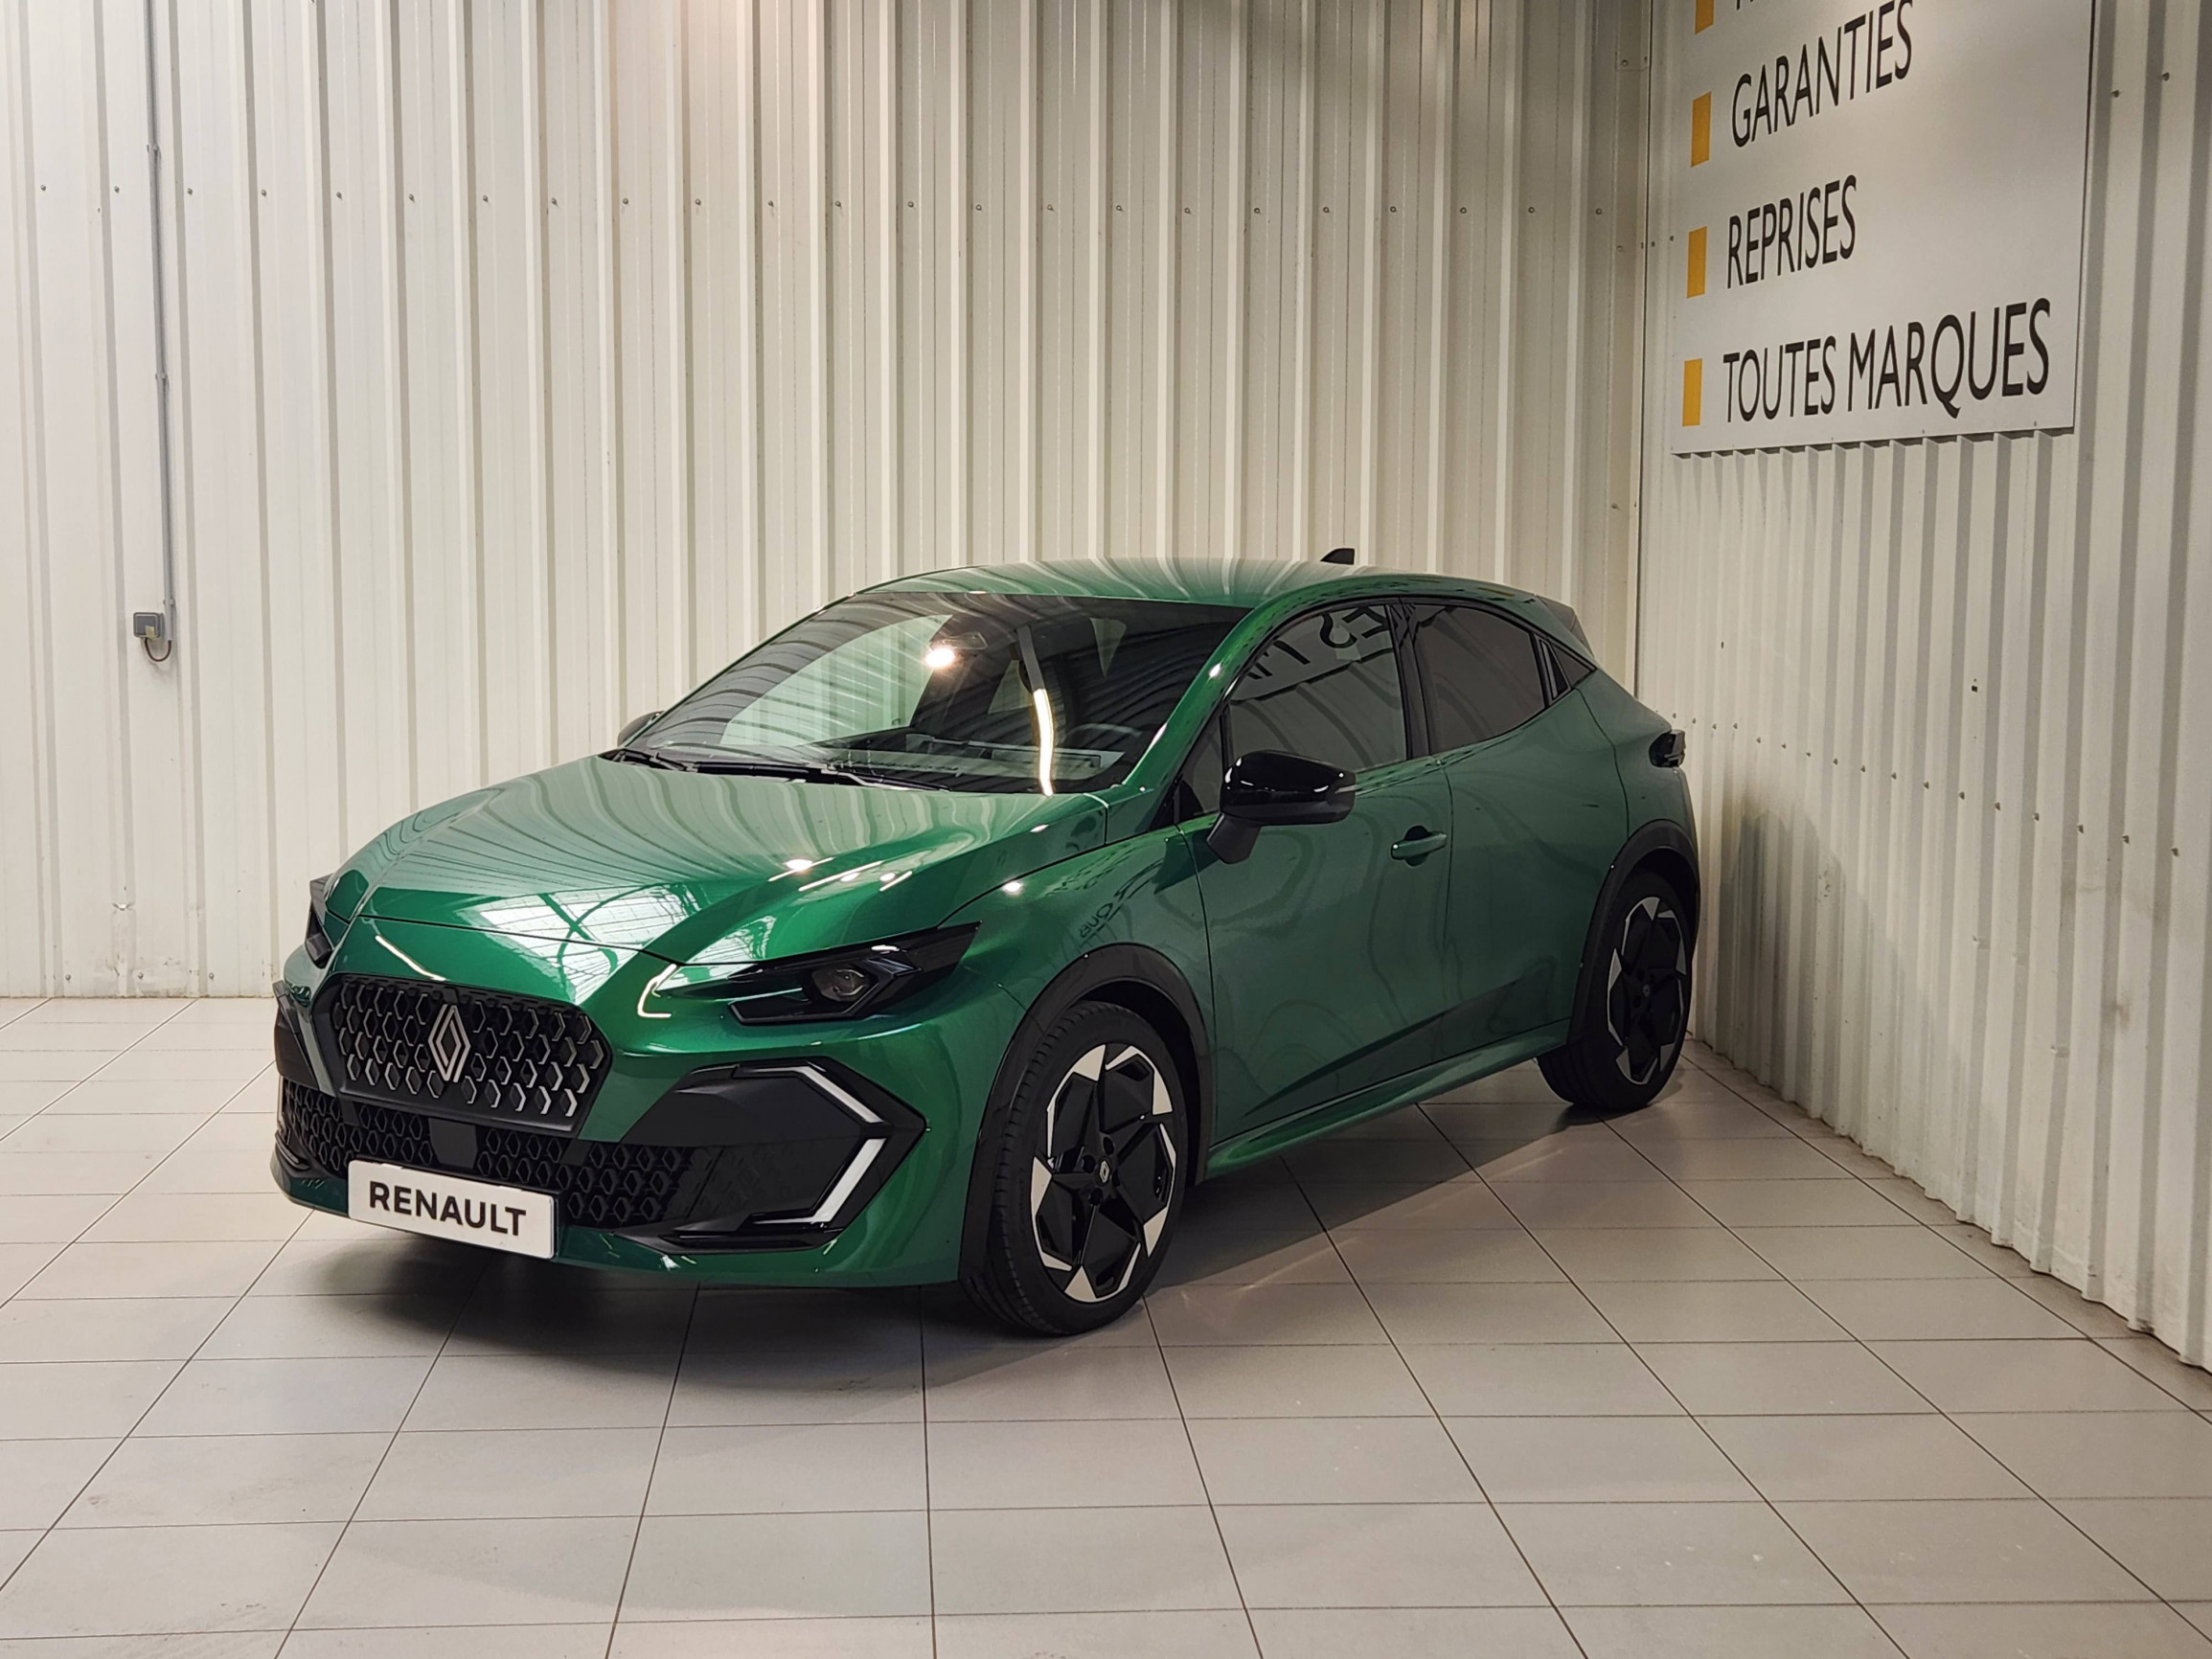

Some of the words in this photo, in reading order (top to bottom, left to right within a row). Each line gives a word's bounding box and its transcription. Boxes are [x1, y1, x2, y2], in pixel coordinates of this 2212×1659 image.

[1731, 0, 1913, 148] GARANTIES
[1727, 174, 1857, 289] REPRISES
[1722, 335, 1836, 423] TOUTES
[1847, 297, 2051, 420] MARQUES
[369, 1180, 527, 1237] RENAULT
